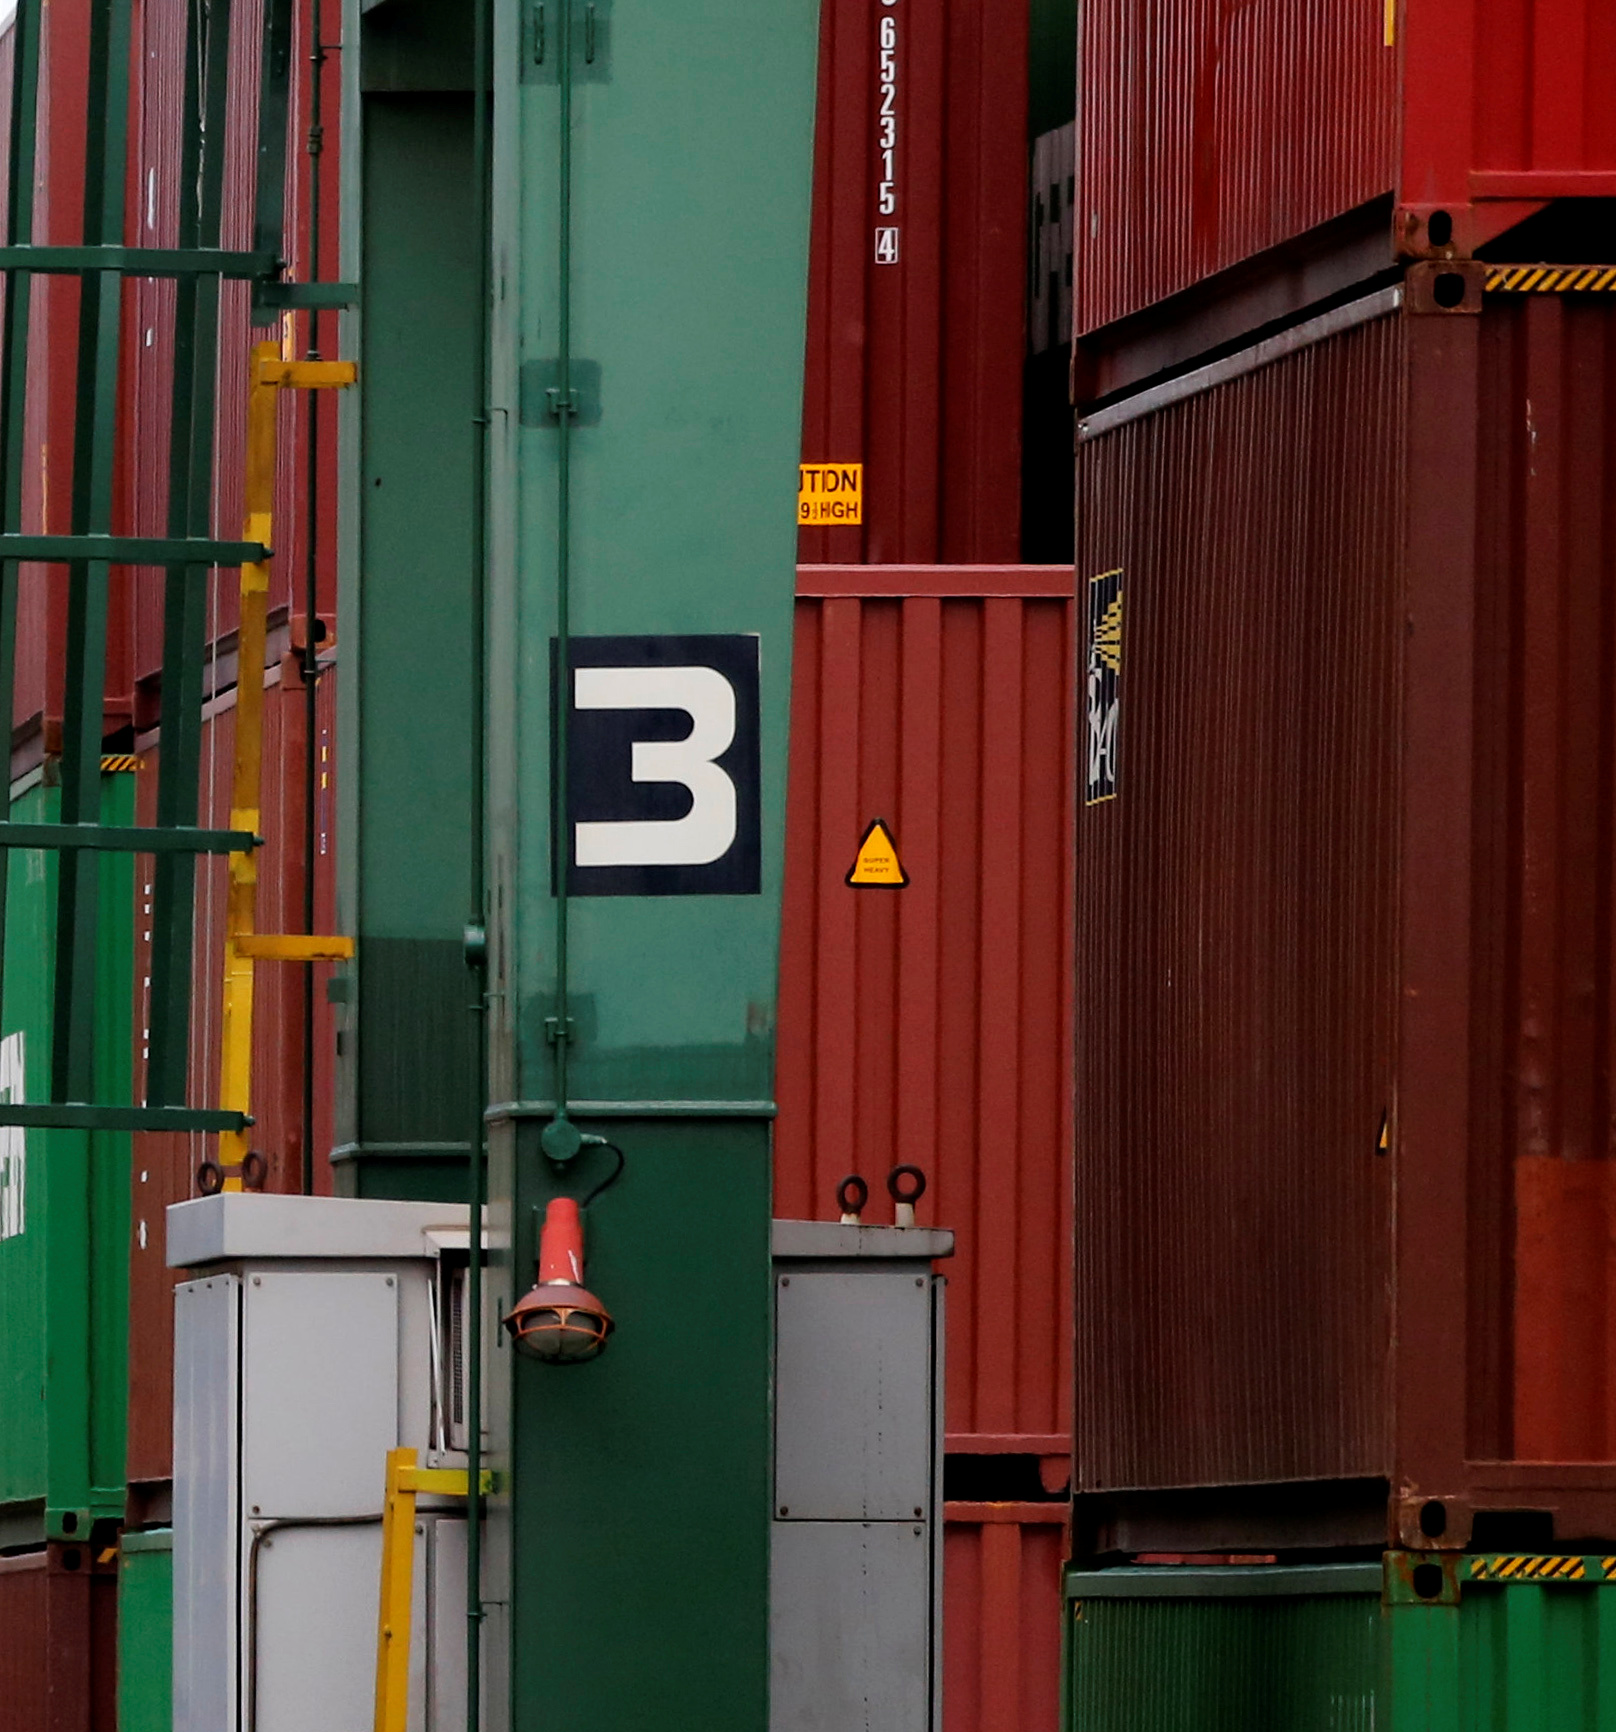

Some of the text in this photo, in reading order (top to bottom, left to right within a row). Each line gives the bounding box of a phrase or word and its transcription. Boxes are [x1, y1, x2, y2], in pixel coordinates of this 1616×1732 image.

[879, 16, 896, 215] 652315
[877, 229, 897, 264] 4
[575, 667, 737, 867] 3
